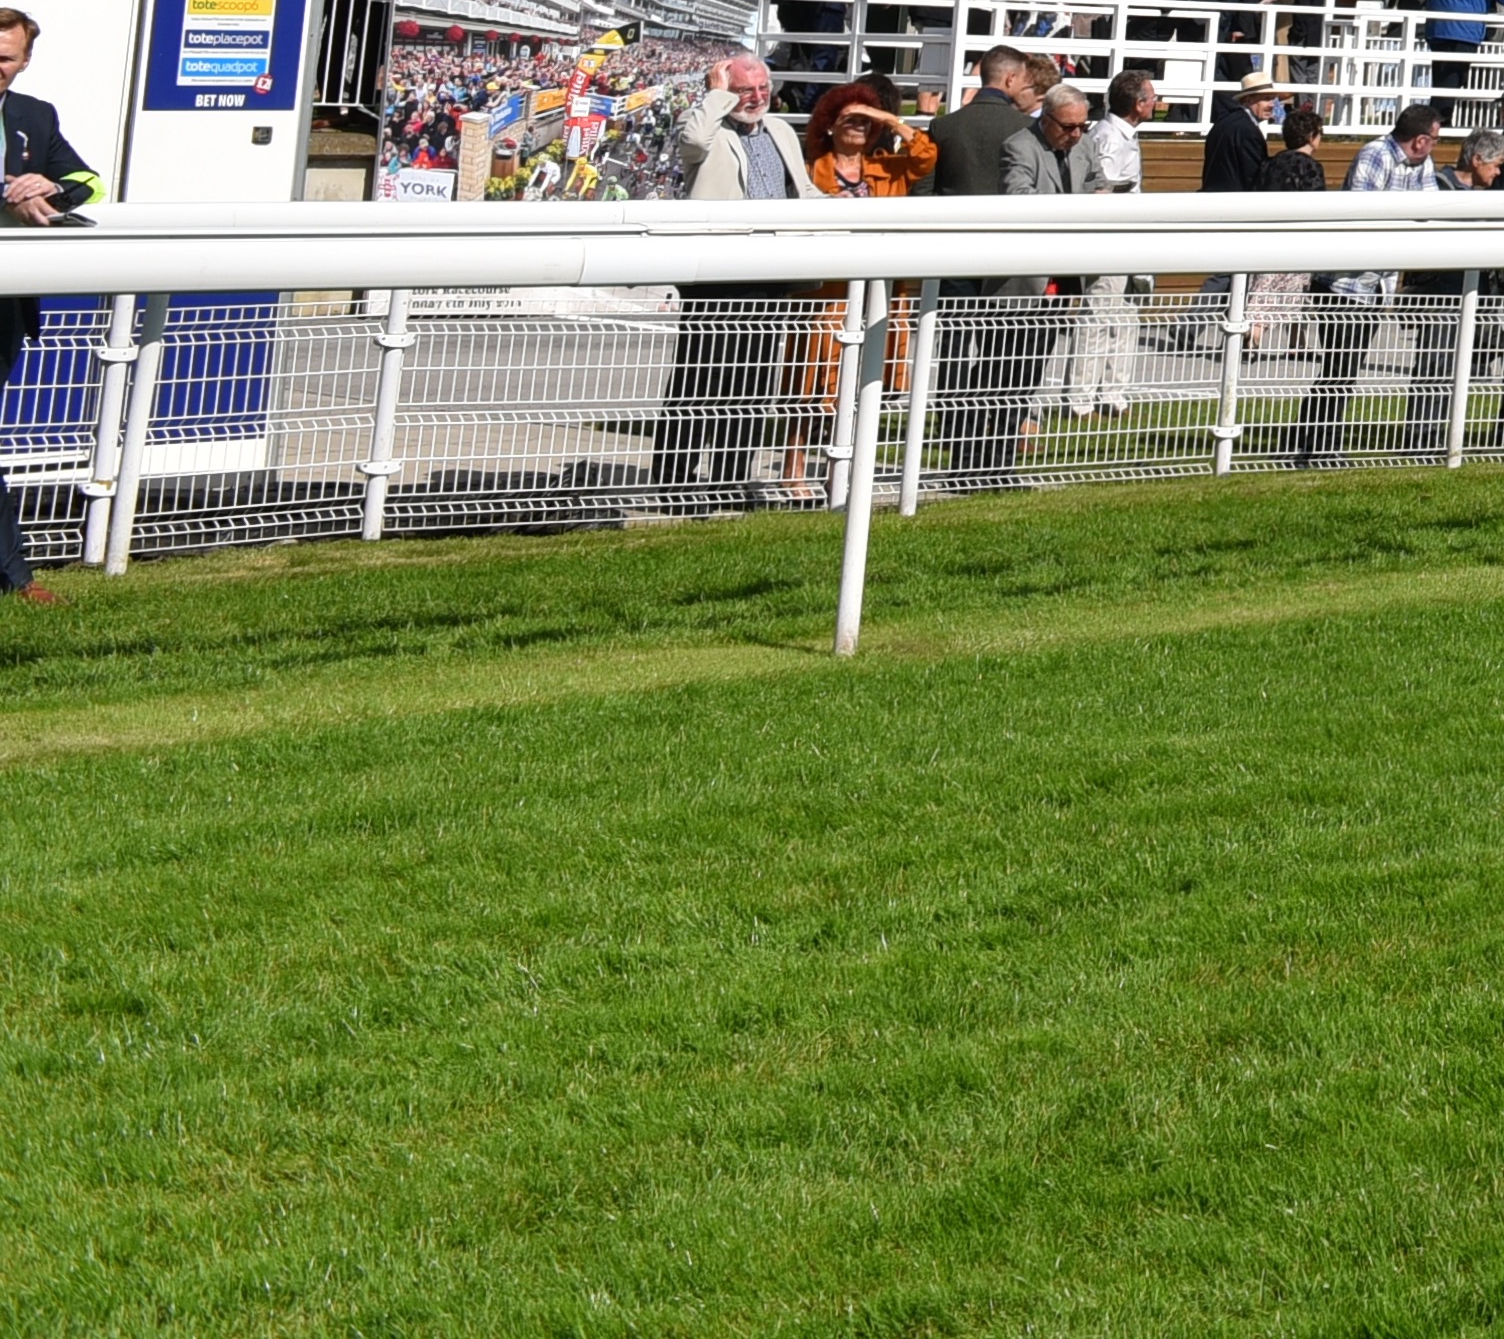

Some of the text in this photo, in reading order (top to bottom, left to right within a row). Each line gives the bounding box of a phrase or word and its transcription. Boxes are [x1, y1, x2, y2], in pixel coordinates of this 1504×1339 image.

[192, 0, 259, 12] totescoop6
[188, 32, 263, 47] toteplacepot
[185, 61, 258, 75] totequadpot
[195, 94, 246, 108] BET NOW
[400, 181, 448, 198] YORK
